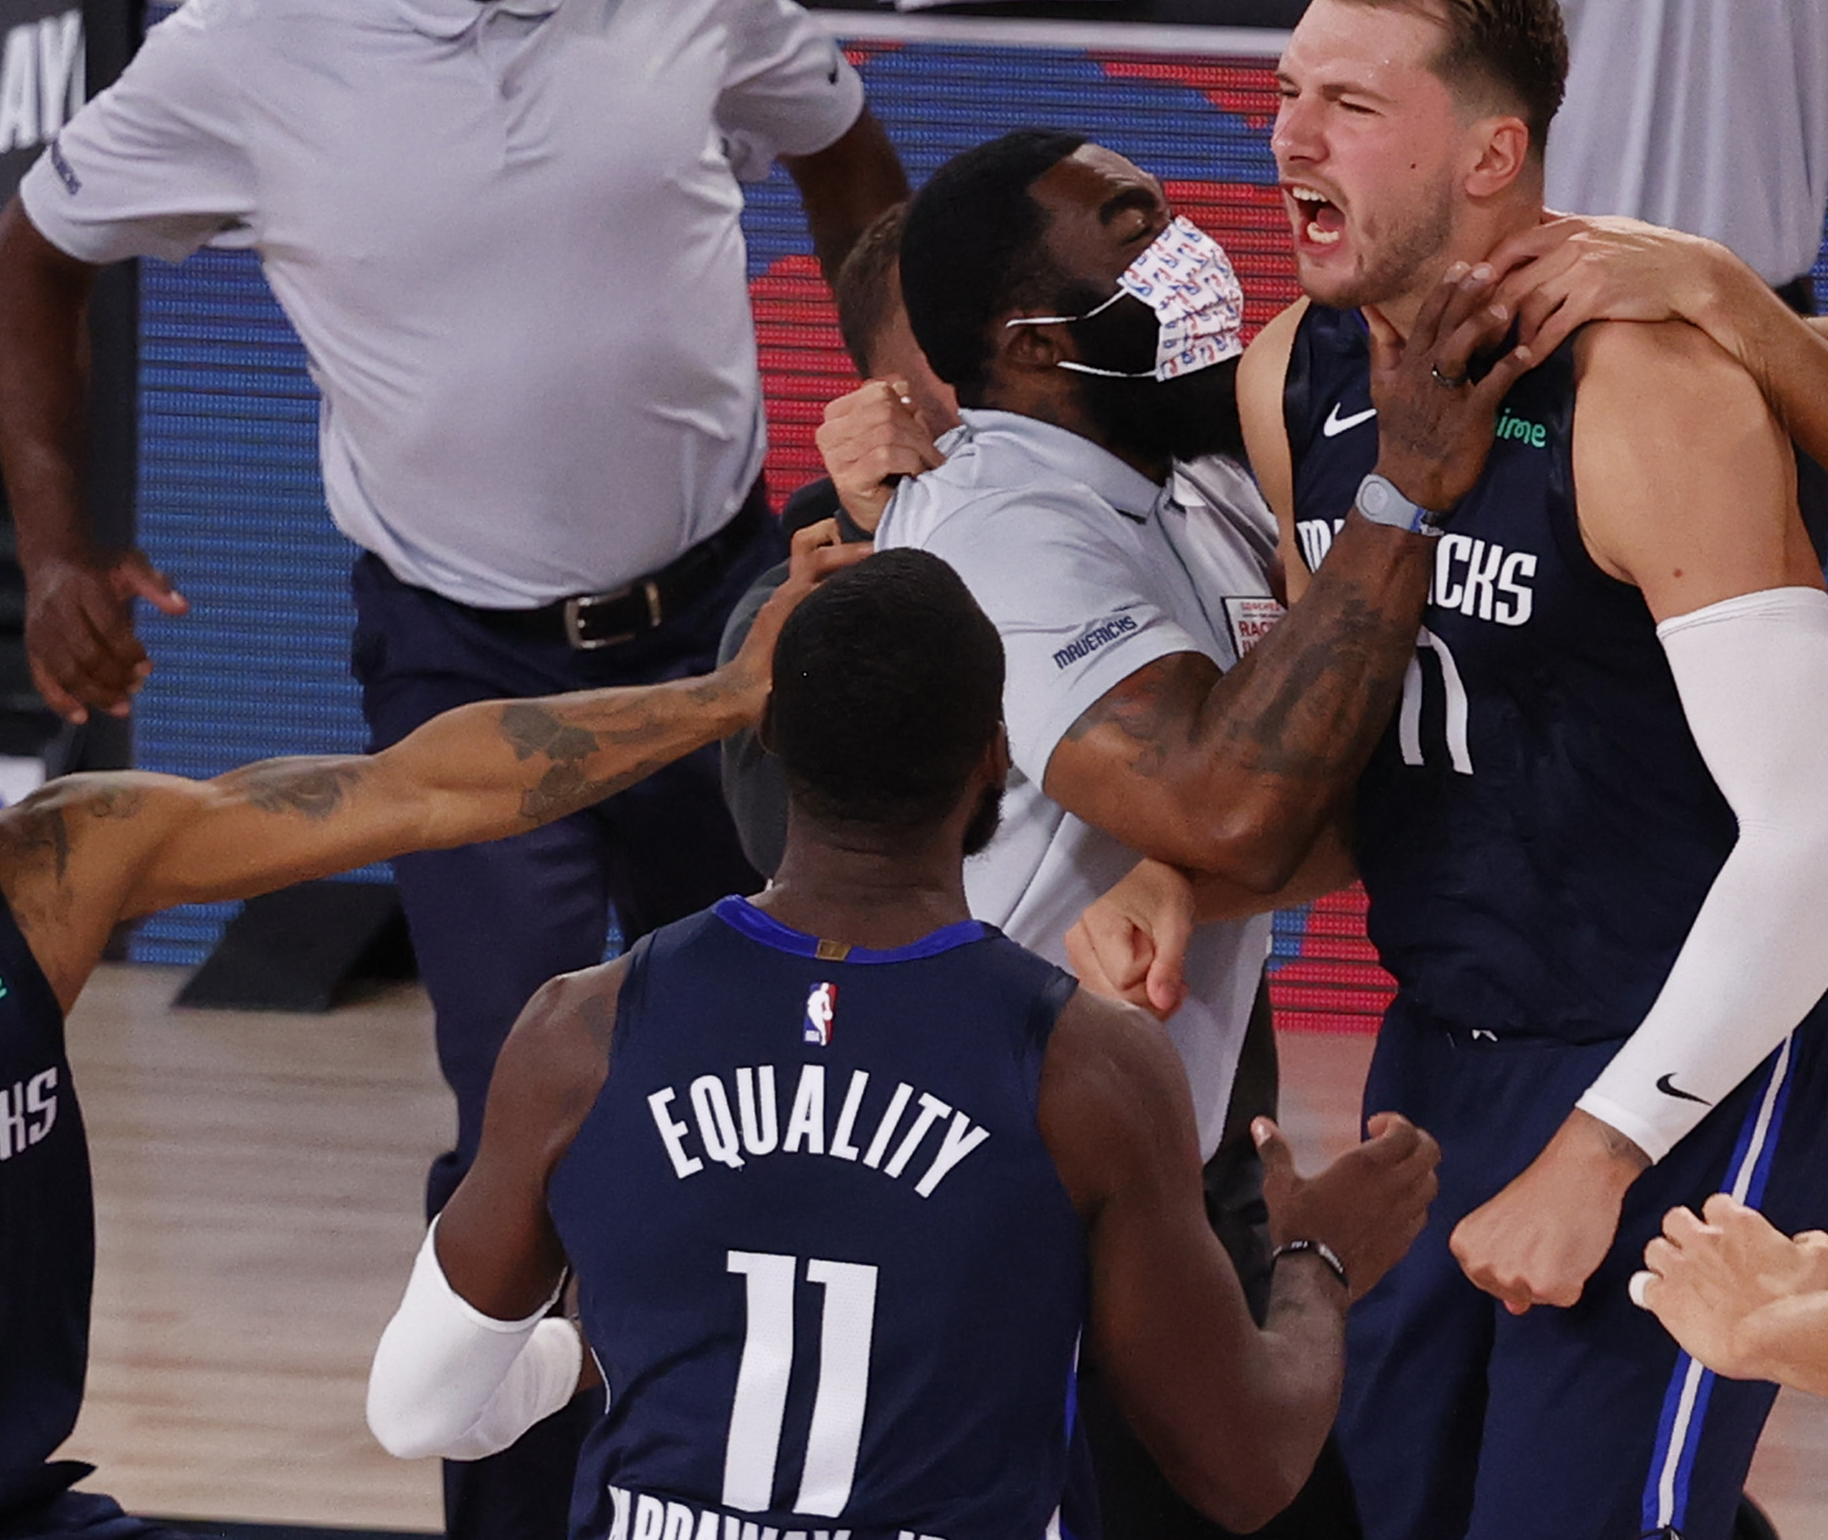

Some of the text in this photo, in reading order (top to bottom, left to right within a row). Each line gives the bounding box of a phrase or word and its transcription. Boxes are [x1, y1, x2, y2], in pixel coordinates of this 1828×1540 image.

[1496, 408, 1547, 448] ime
[1052, 615, 1138, 670] MAVERICKS
[647, 1064, 990, 1198] EQUALITY
[722, 1250, 877, 1517] 11
